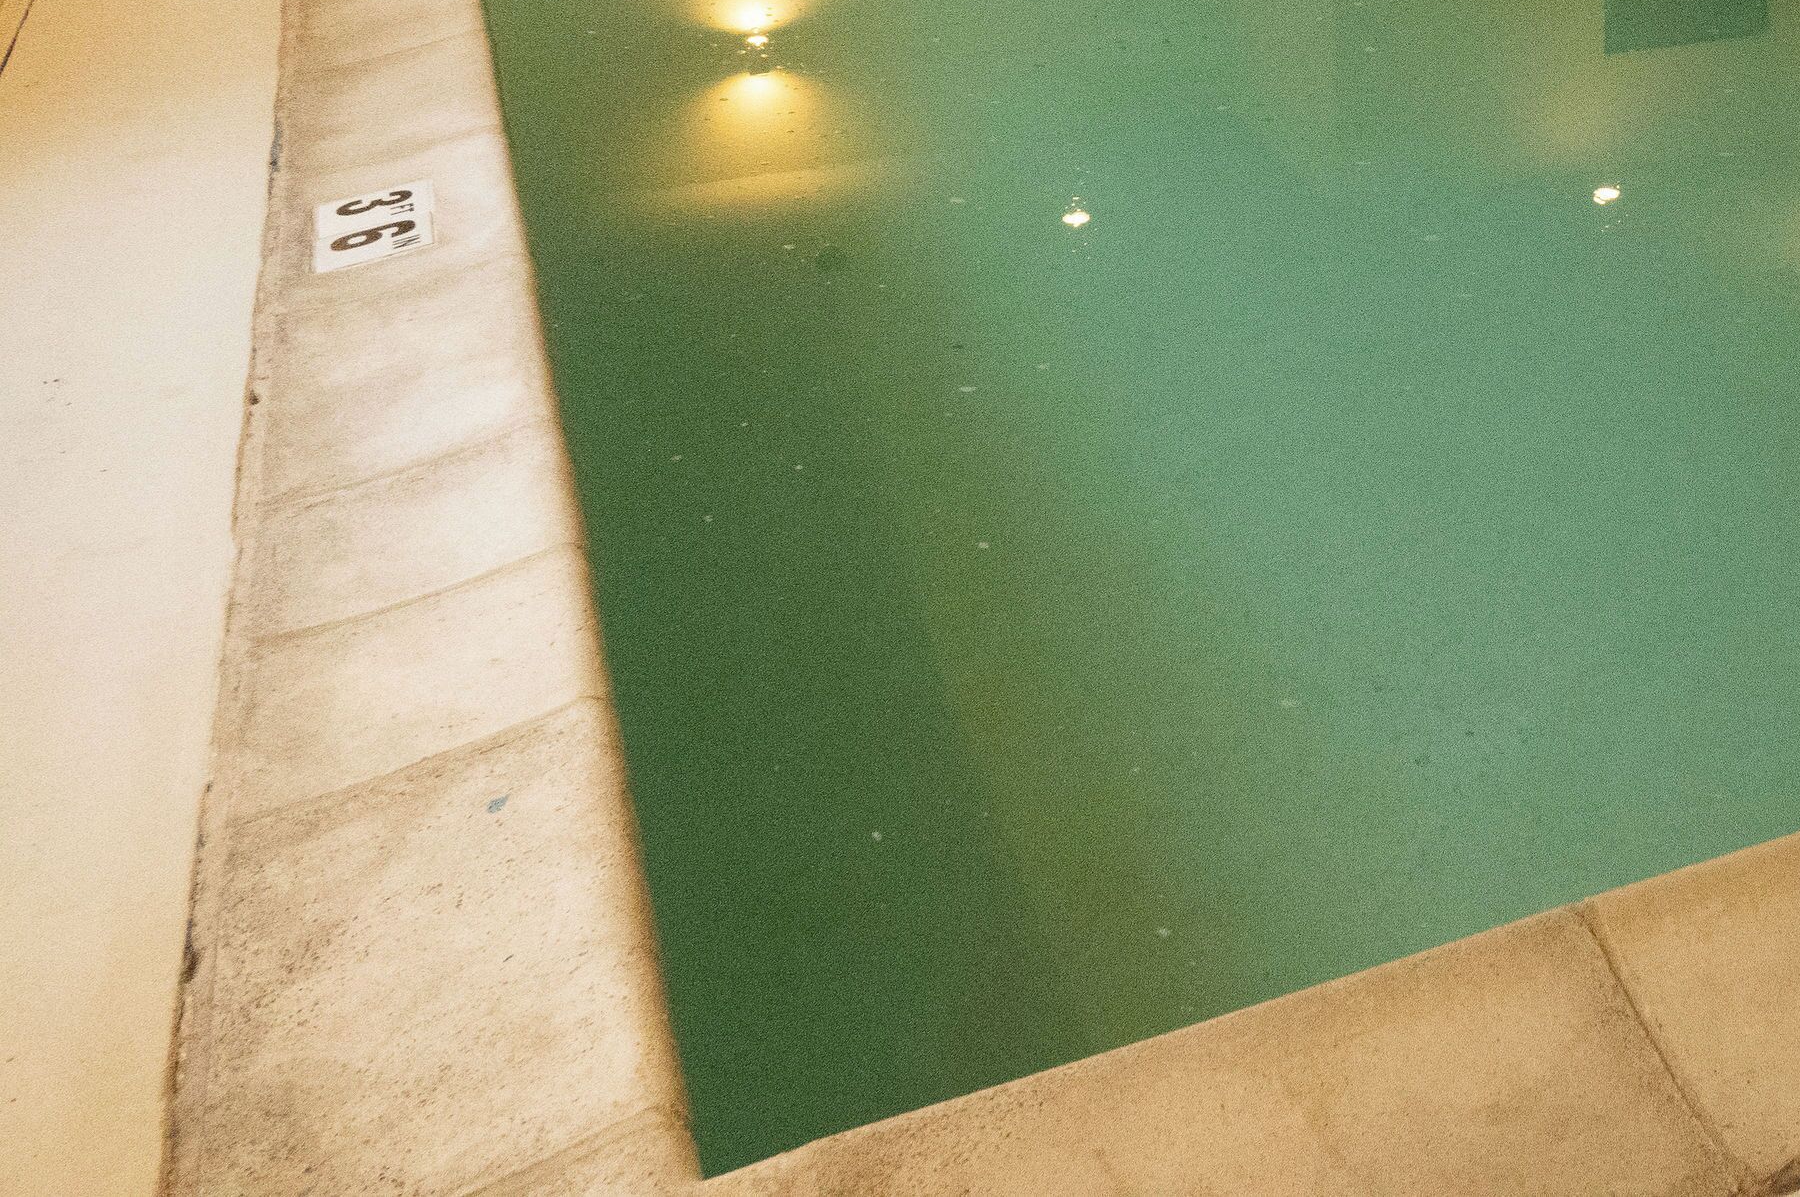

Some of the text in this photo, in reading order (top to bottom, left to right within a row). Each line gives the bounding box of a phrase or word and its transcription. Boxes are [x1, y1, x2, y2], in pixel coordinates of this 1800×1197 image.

[330, 190, 421, 252] 3 FT 6 IN
